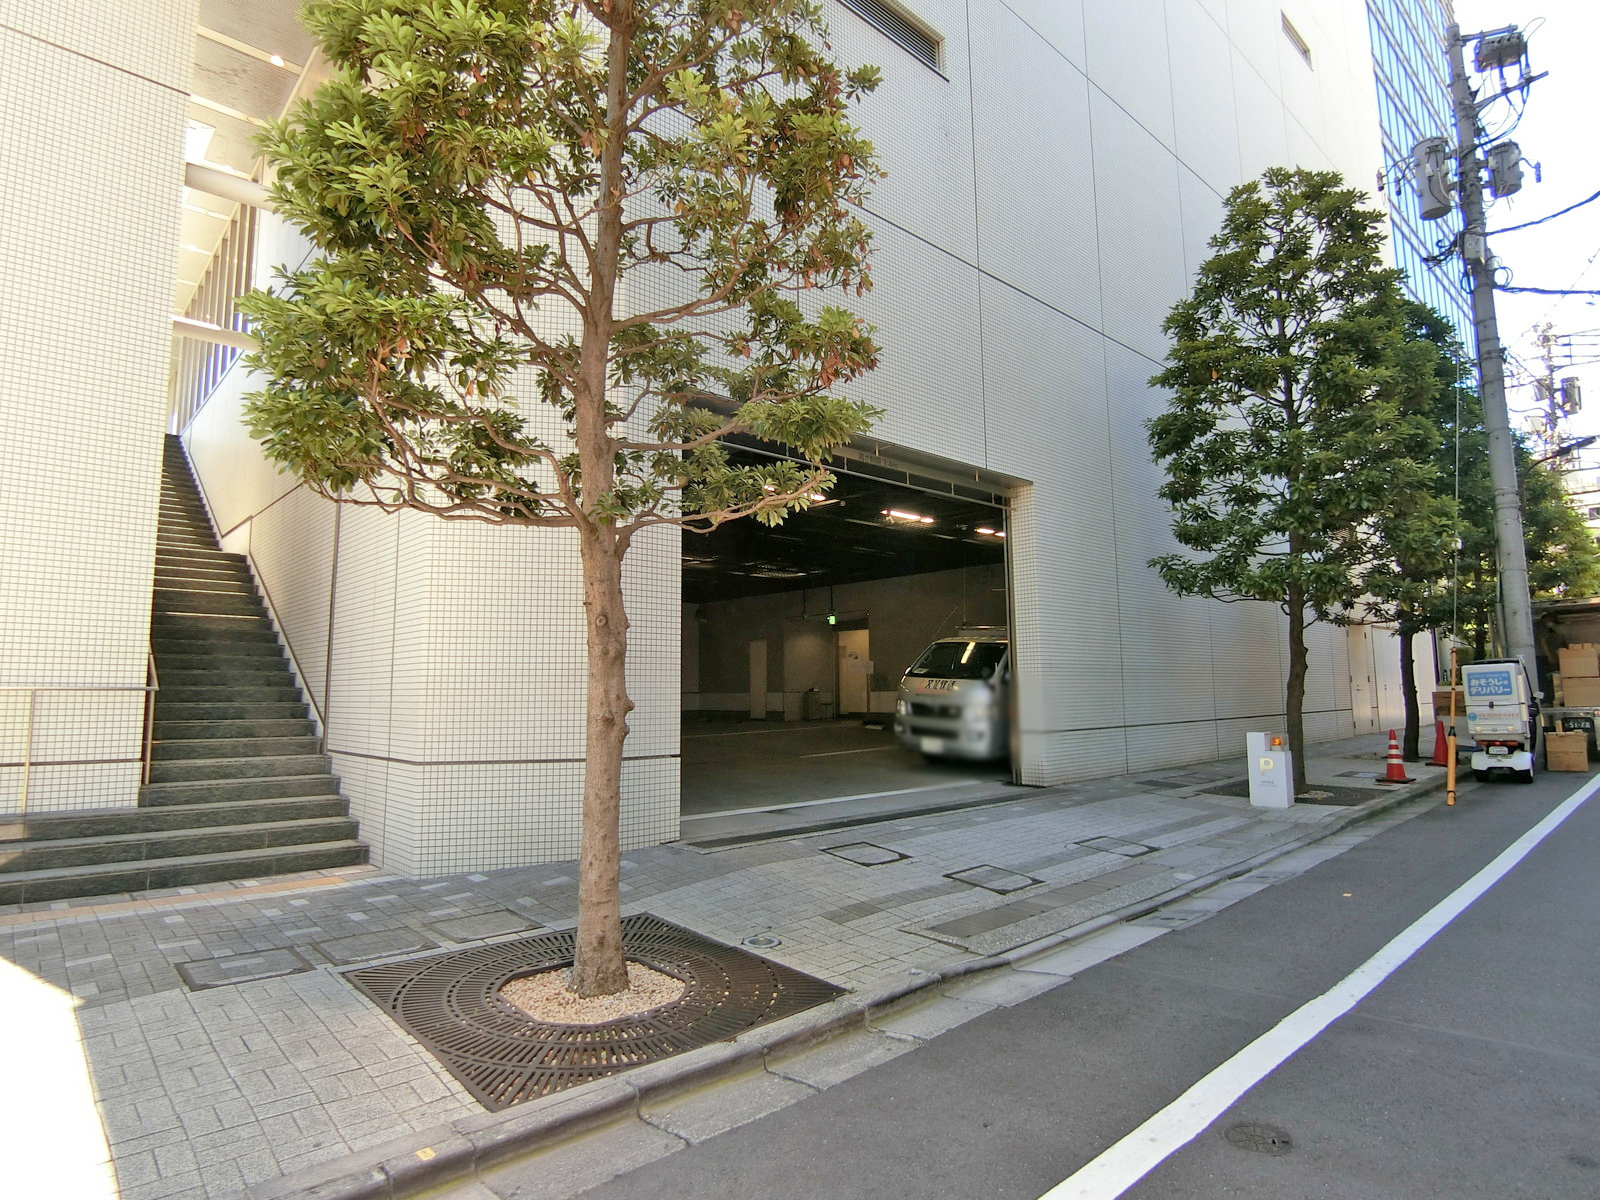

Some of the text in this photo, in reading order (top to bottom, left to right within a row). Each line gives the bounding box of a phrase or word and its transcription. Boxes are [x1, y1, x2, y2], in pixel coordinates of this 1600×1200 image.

[1470, 678, 1509, 686] おそうじの
[1259, 757, 1275, 776] P
